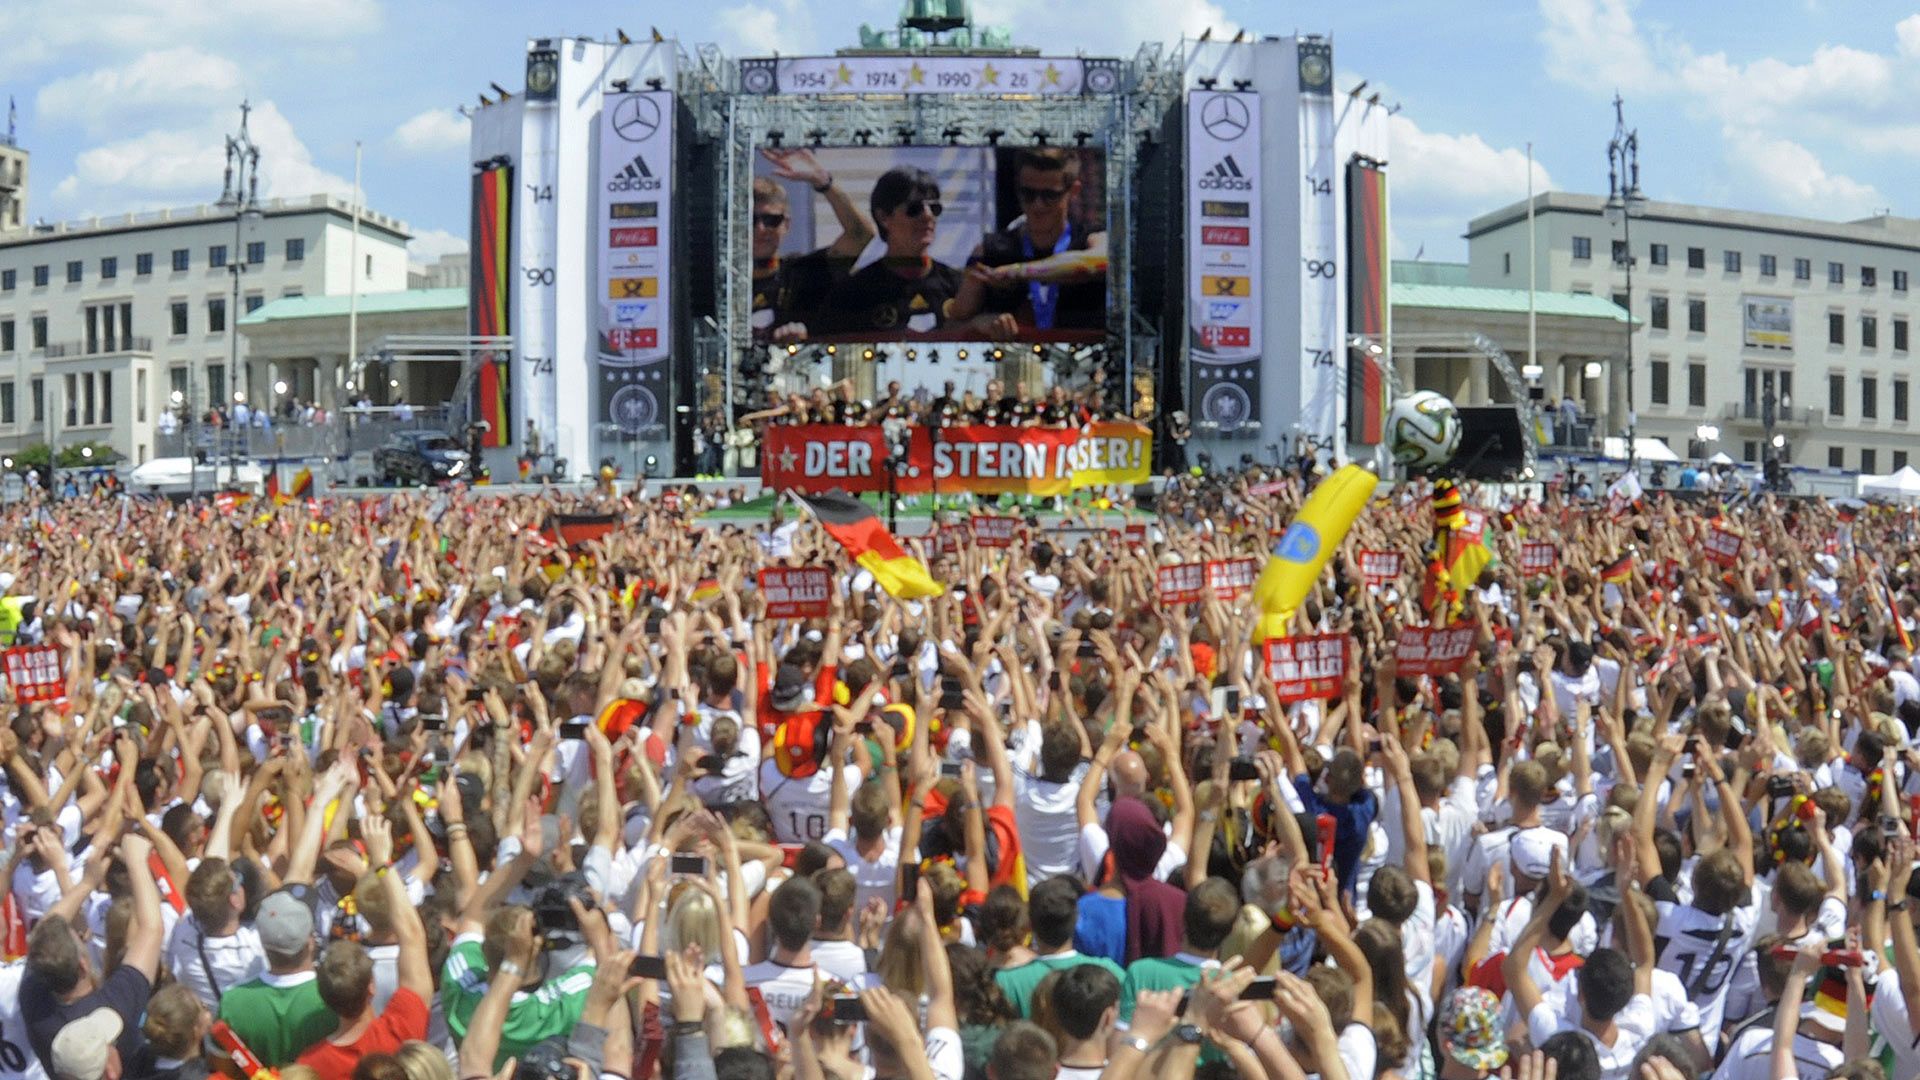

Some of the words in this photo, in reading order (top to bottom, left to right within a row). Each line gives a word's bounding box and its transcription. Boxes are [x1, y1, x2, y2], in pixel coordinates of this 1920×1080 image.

[793, 72, 826, 87] 1954
[866, 72, 897, 86] 1974
[937, 72, 971, 86] 1990
[608, 177, 661, 192] adidas
[1199, 176, 1253, 191] adidas
[804, 440, 873, 477] DER
[933, 441, 1048, 478] STERN
[789, 811, 825, 839] 10
